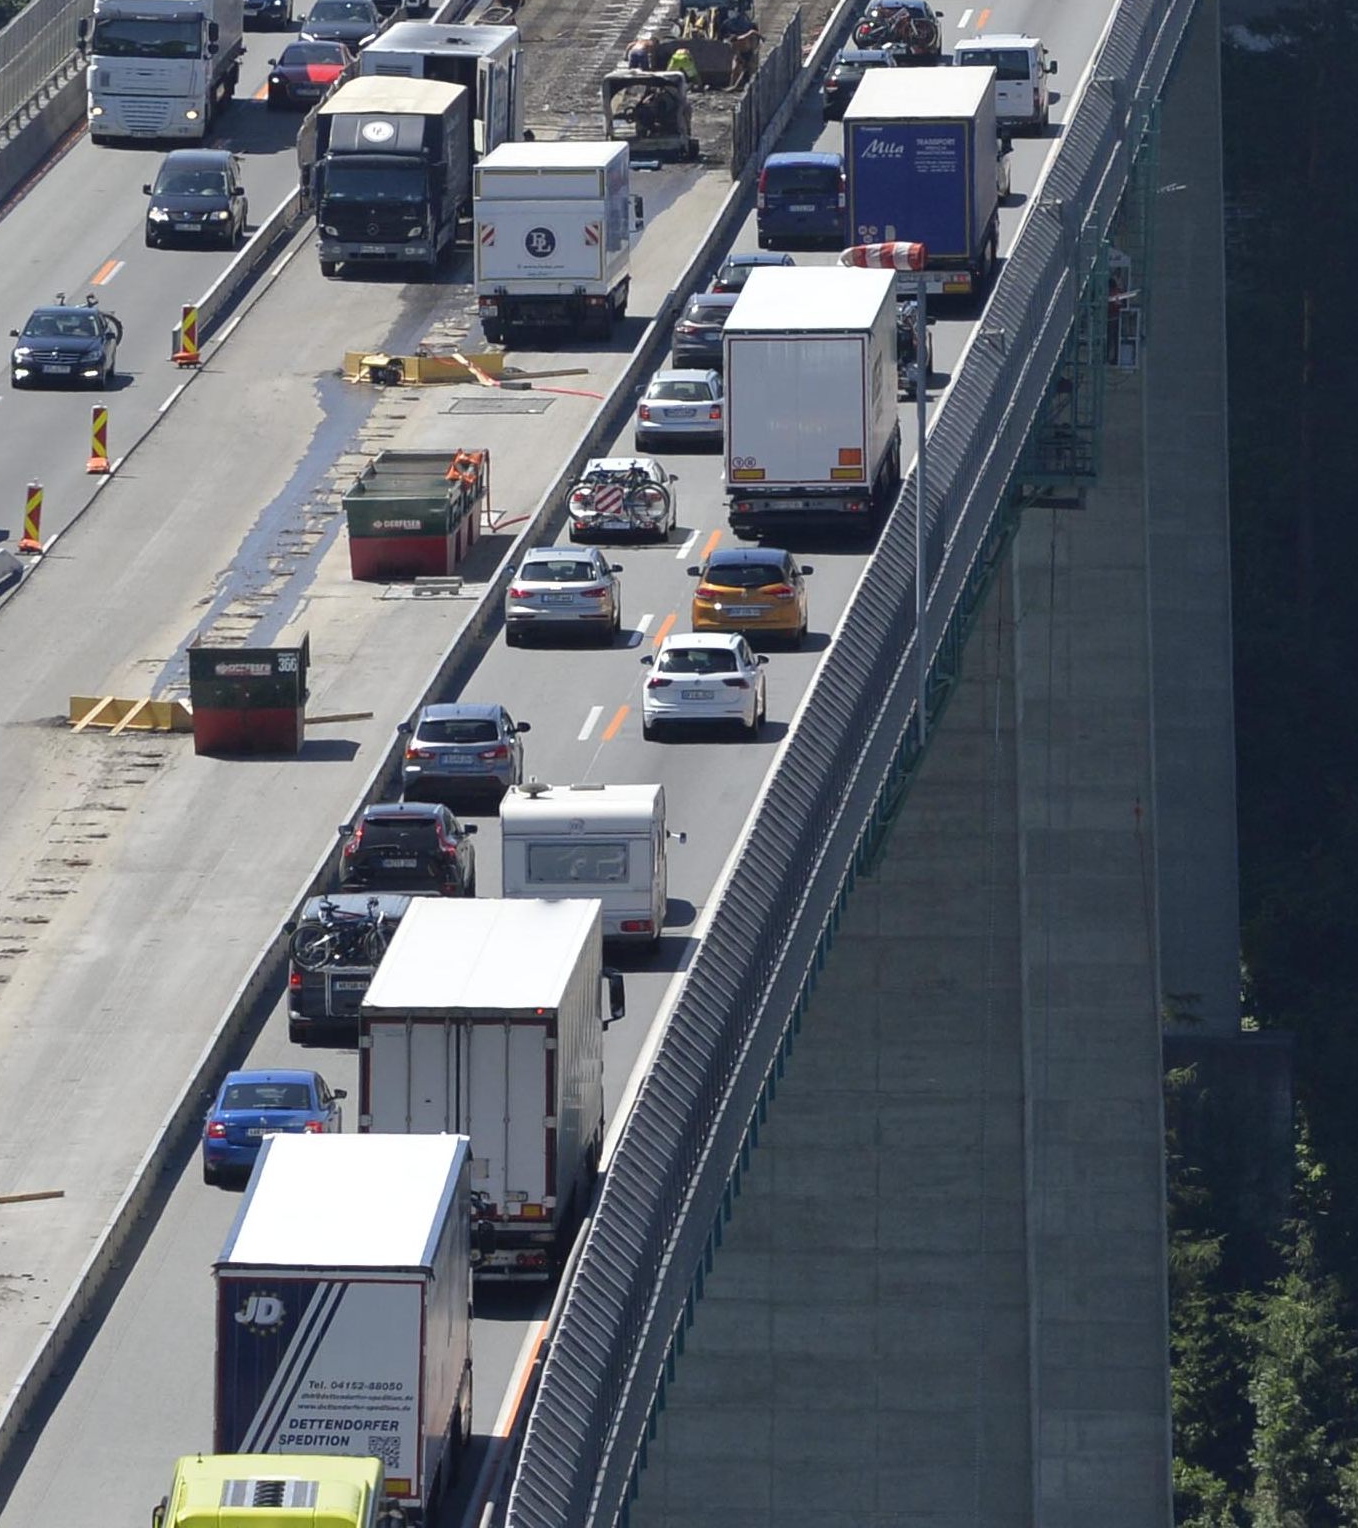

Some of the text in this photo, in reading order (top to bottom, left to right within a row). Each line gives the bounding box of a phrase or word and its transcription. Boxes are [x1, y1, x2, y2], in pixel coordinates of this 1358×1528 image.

[861, 138, 905, 158] Mila
[278, 657, 297, 672] 366
[234, 1296, 283, 1326] JD
[308, 1380, 327, 1390] Tel.
[288, 1418, 399, 1432] DETTENDORFER
[278, 1434, 351, 1447] SPEDITION
